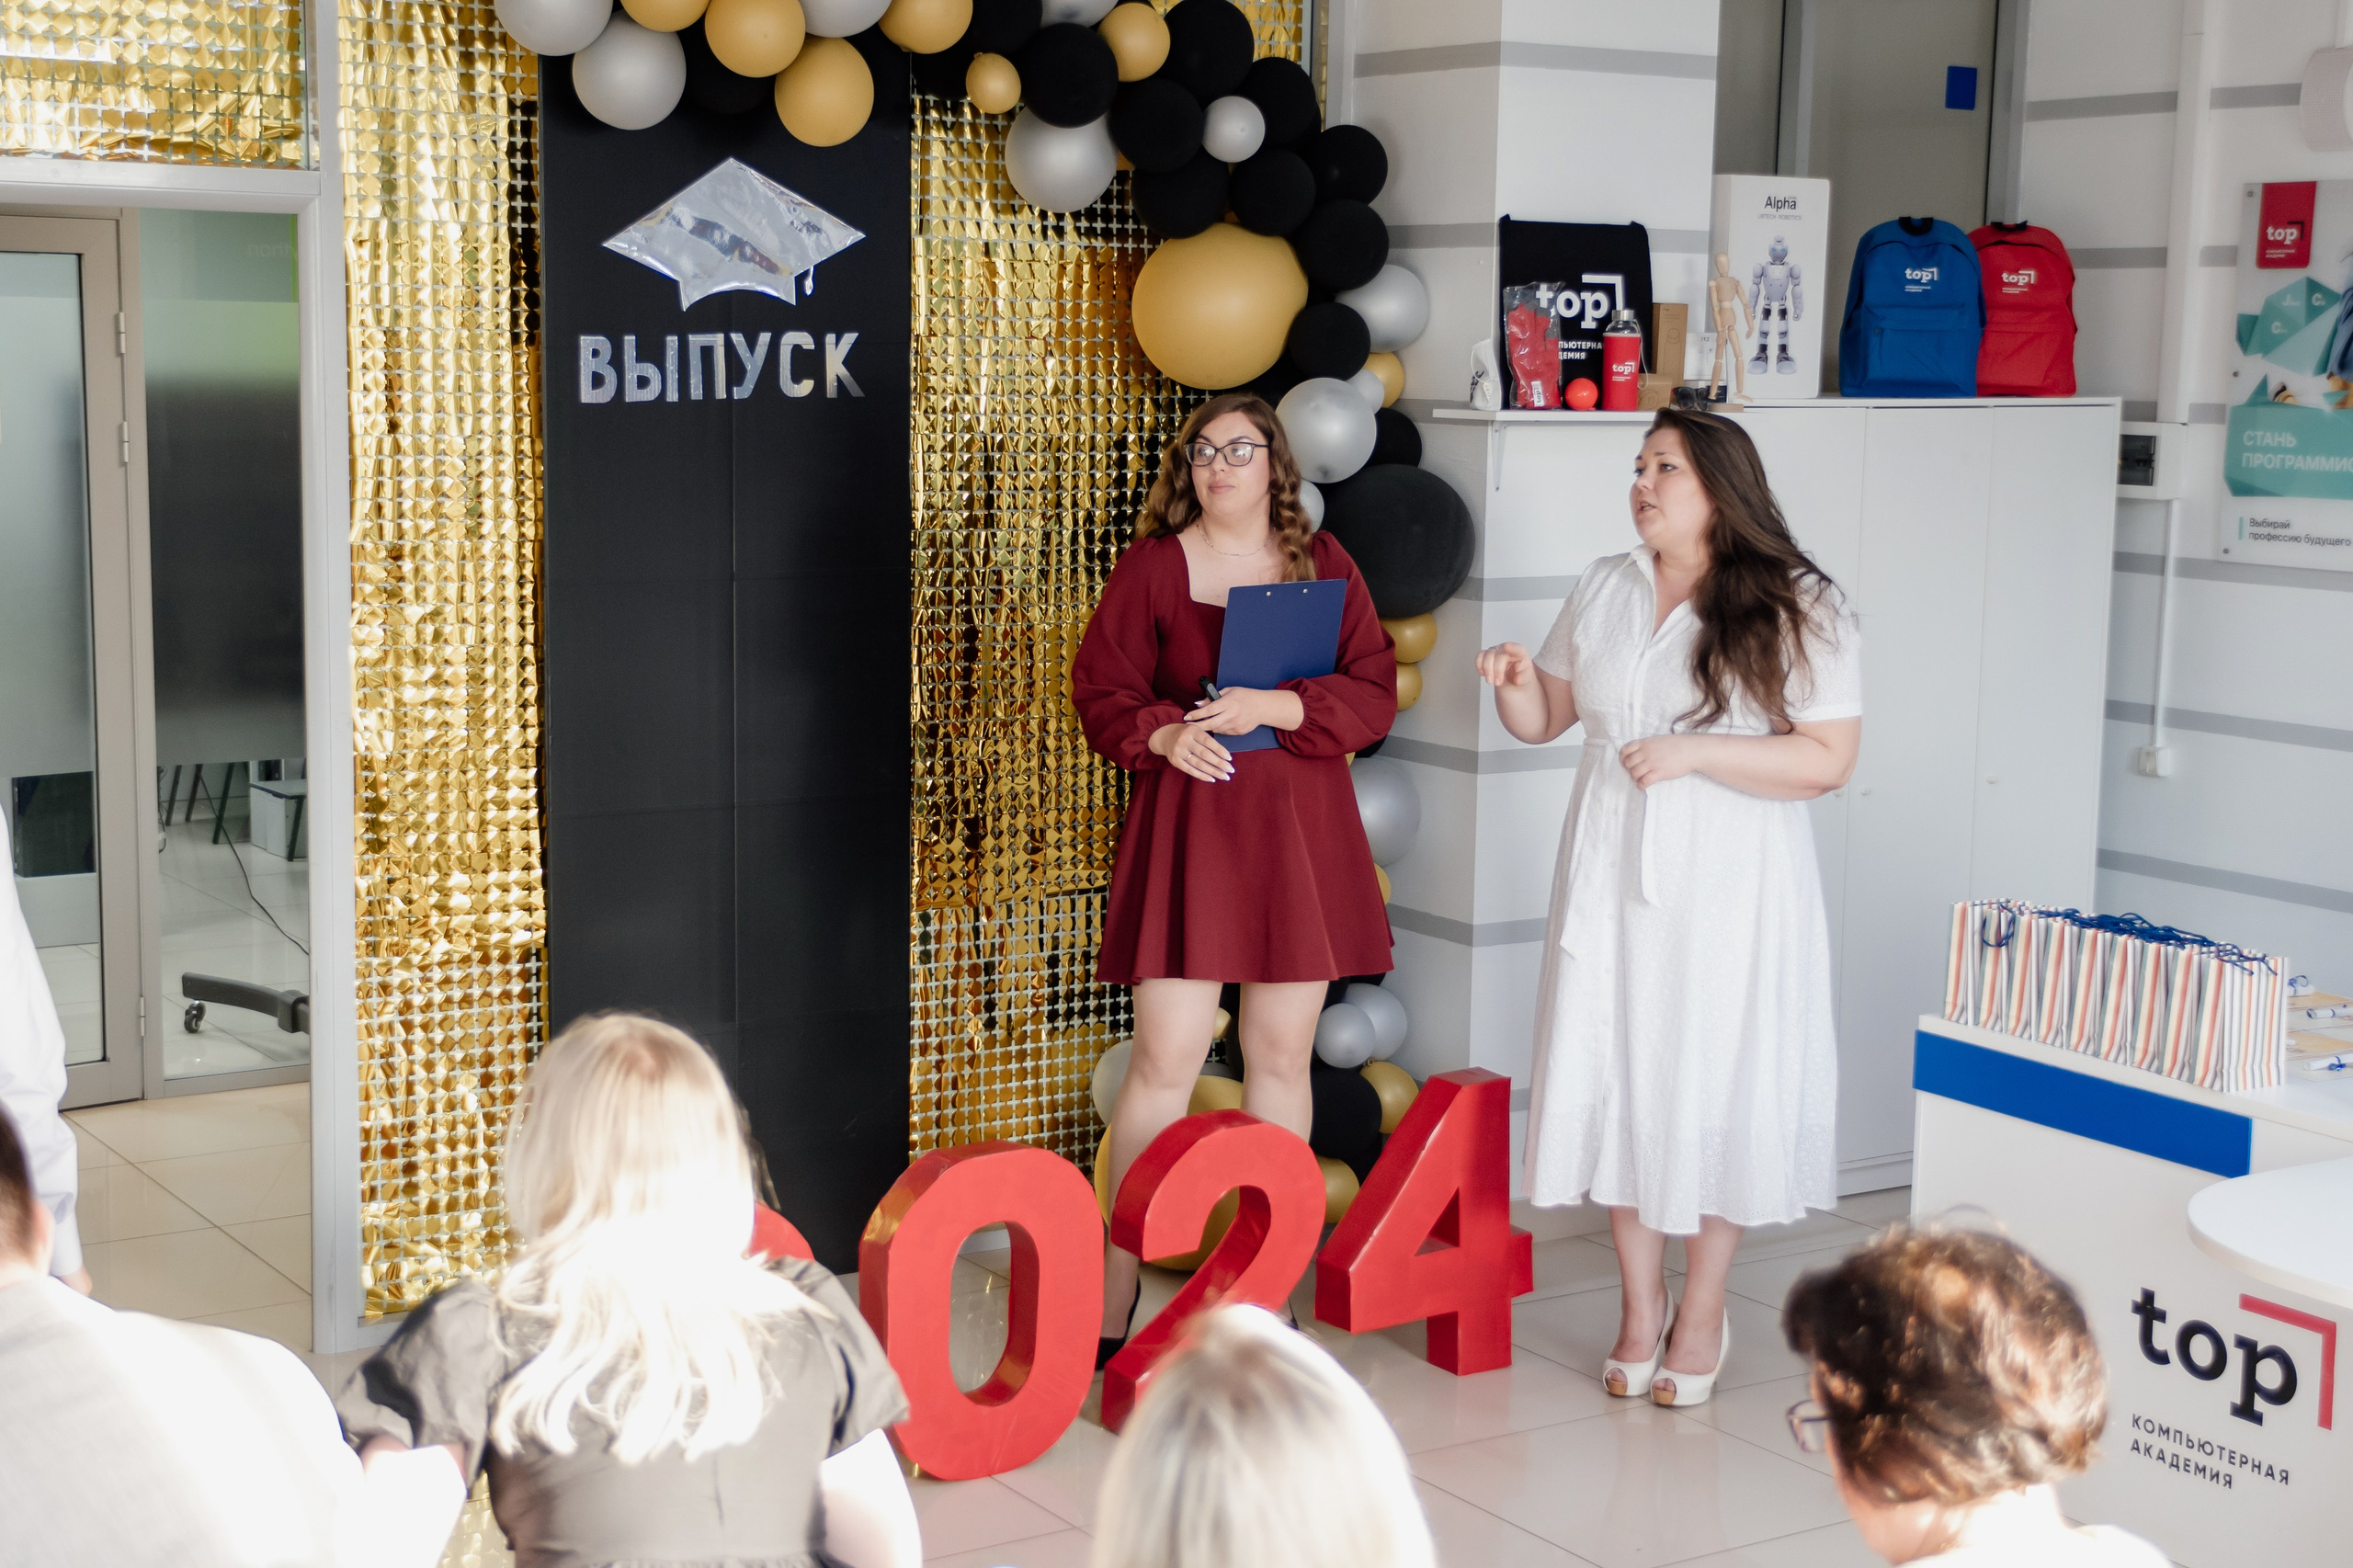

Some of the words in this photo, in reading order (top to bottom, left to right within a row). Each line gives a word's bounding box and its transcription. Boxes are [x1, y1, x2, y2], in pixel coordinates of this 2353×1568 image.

[1765, 196, 1797, 212] Alpha
[2266, 226, 2298, 245] top
[1904, 267, 1932, 283] top
[2002, 272, 2029, 286] top
[1535, 283, 1608, 329] top
[1558, 341, 1602, 349] ПЬЮТЕРНА
[1558, 351, 1586, 360] ДЕМИЯ
[579, 332, 866, 403] ВЫПУСК
[1612, 364, 1631, 375] top
[2243, 430, 2297, 448] СТАНЬ
[2249, 517, 2290, 530] Выбирай
[2248, 532, 2302, 544] профессию
[2303, 534, 2351, 547] будущего
[741, 1067, 1533, 1482] 024
[2131, 1287, 2298, 1426] top
[2131, 1413, 2290, 1485] КОМПЬЮТЕРНАЯ
[2130, 1438, 2233, 1489] АКАДЕМИЯ
